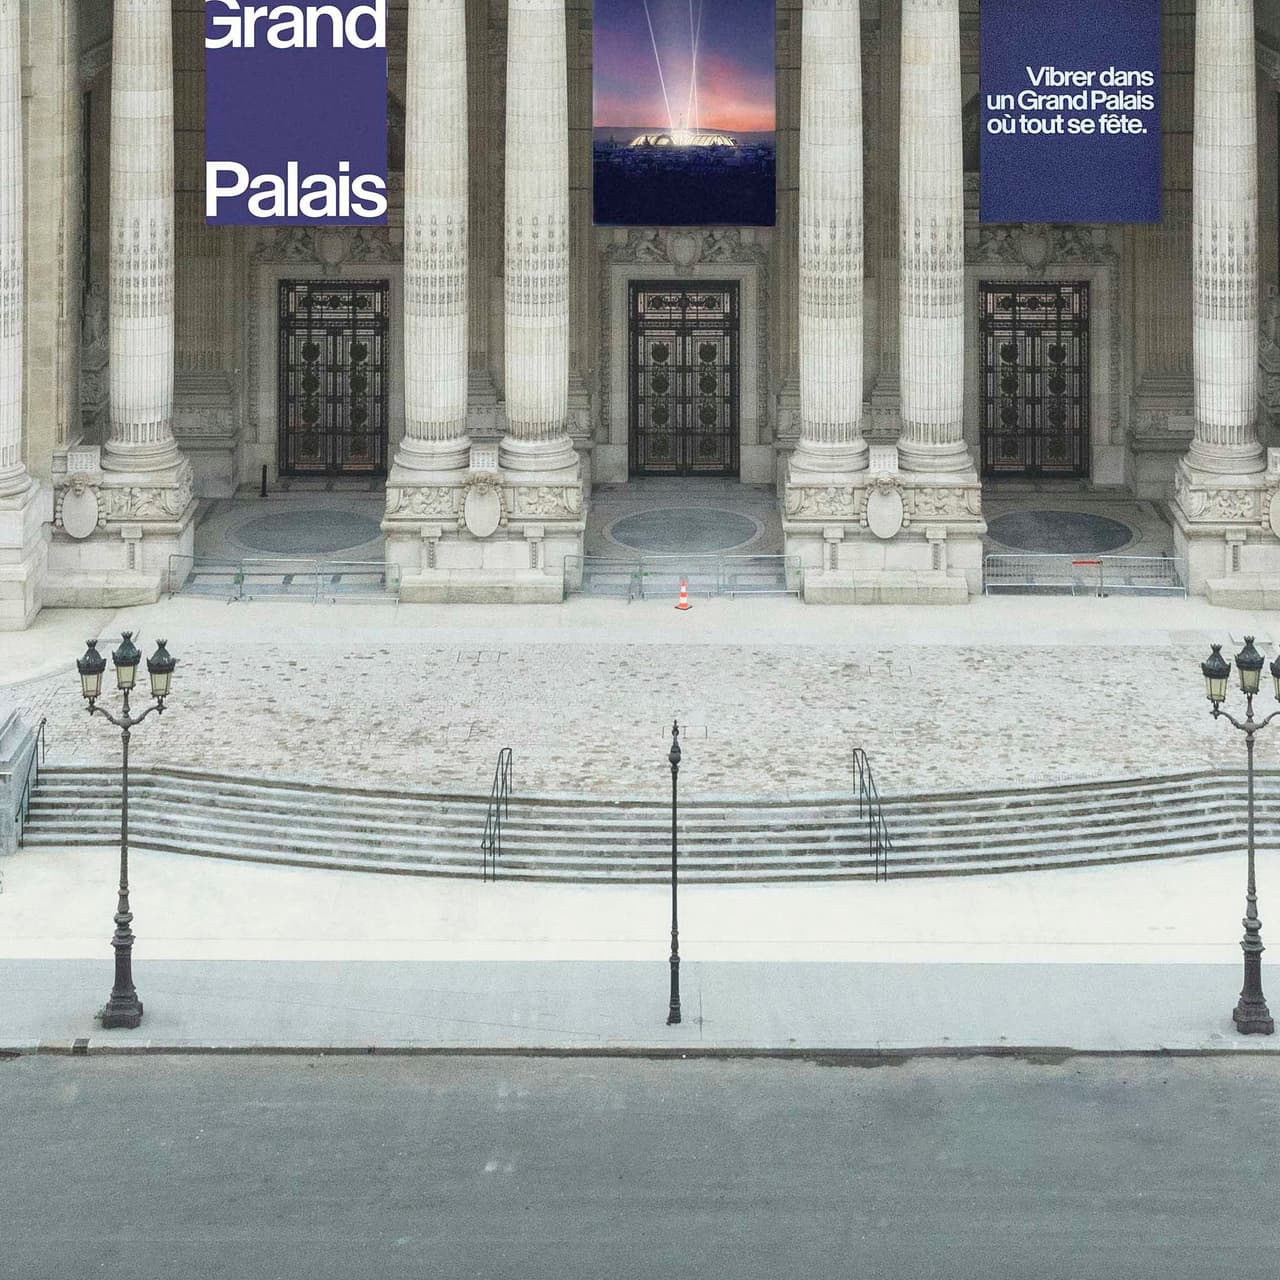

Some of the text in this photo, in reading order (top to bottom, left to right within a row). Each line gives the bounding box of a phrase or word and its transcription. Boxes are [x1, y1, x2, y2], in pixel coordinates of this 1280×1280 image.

[1026, 66, 1154, 87] Vibrer dans
[986, 90, 1154, 110] un Grand Palais
[987, 114, 1147, 134] où tout se fête.
[206, 161, 387, 217] Palais
